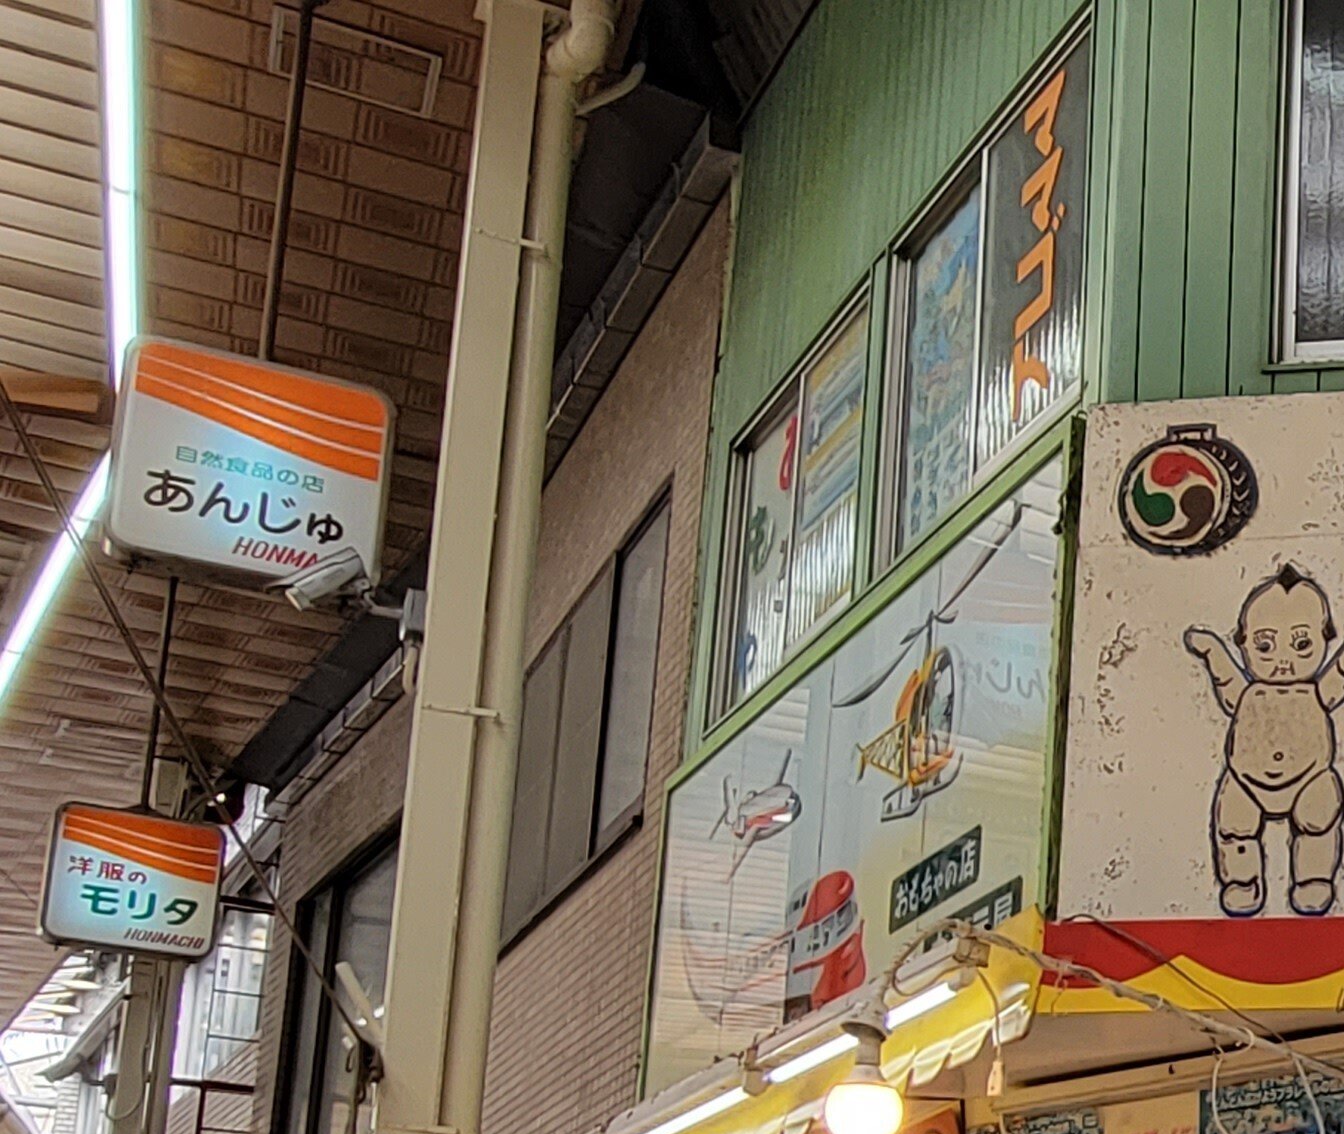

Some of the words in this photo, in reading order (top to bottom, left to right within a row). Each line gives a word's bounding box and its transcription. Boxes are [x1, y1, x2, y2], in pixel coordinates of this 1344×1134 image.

[1011, 68, 1066, 422] ママゴト
[175, 445, 325, 494] 自然食品の店
[143, 468, 344, 545] あんじゅ
[67, 855, 148, 886] 洋服の
[893, 838, 978, 922] おもちゃの店
[79, 882, 199, 926] モリタ
[122, 926, 206, 951] HONMACHI
